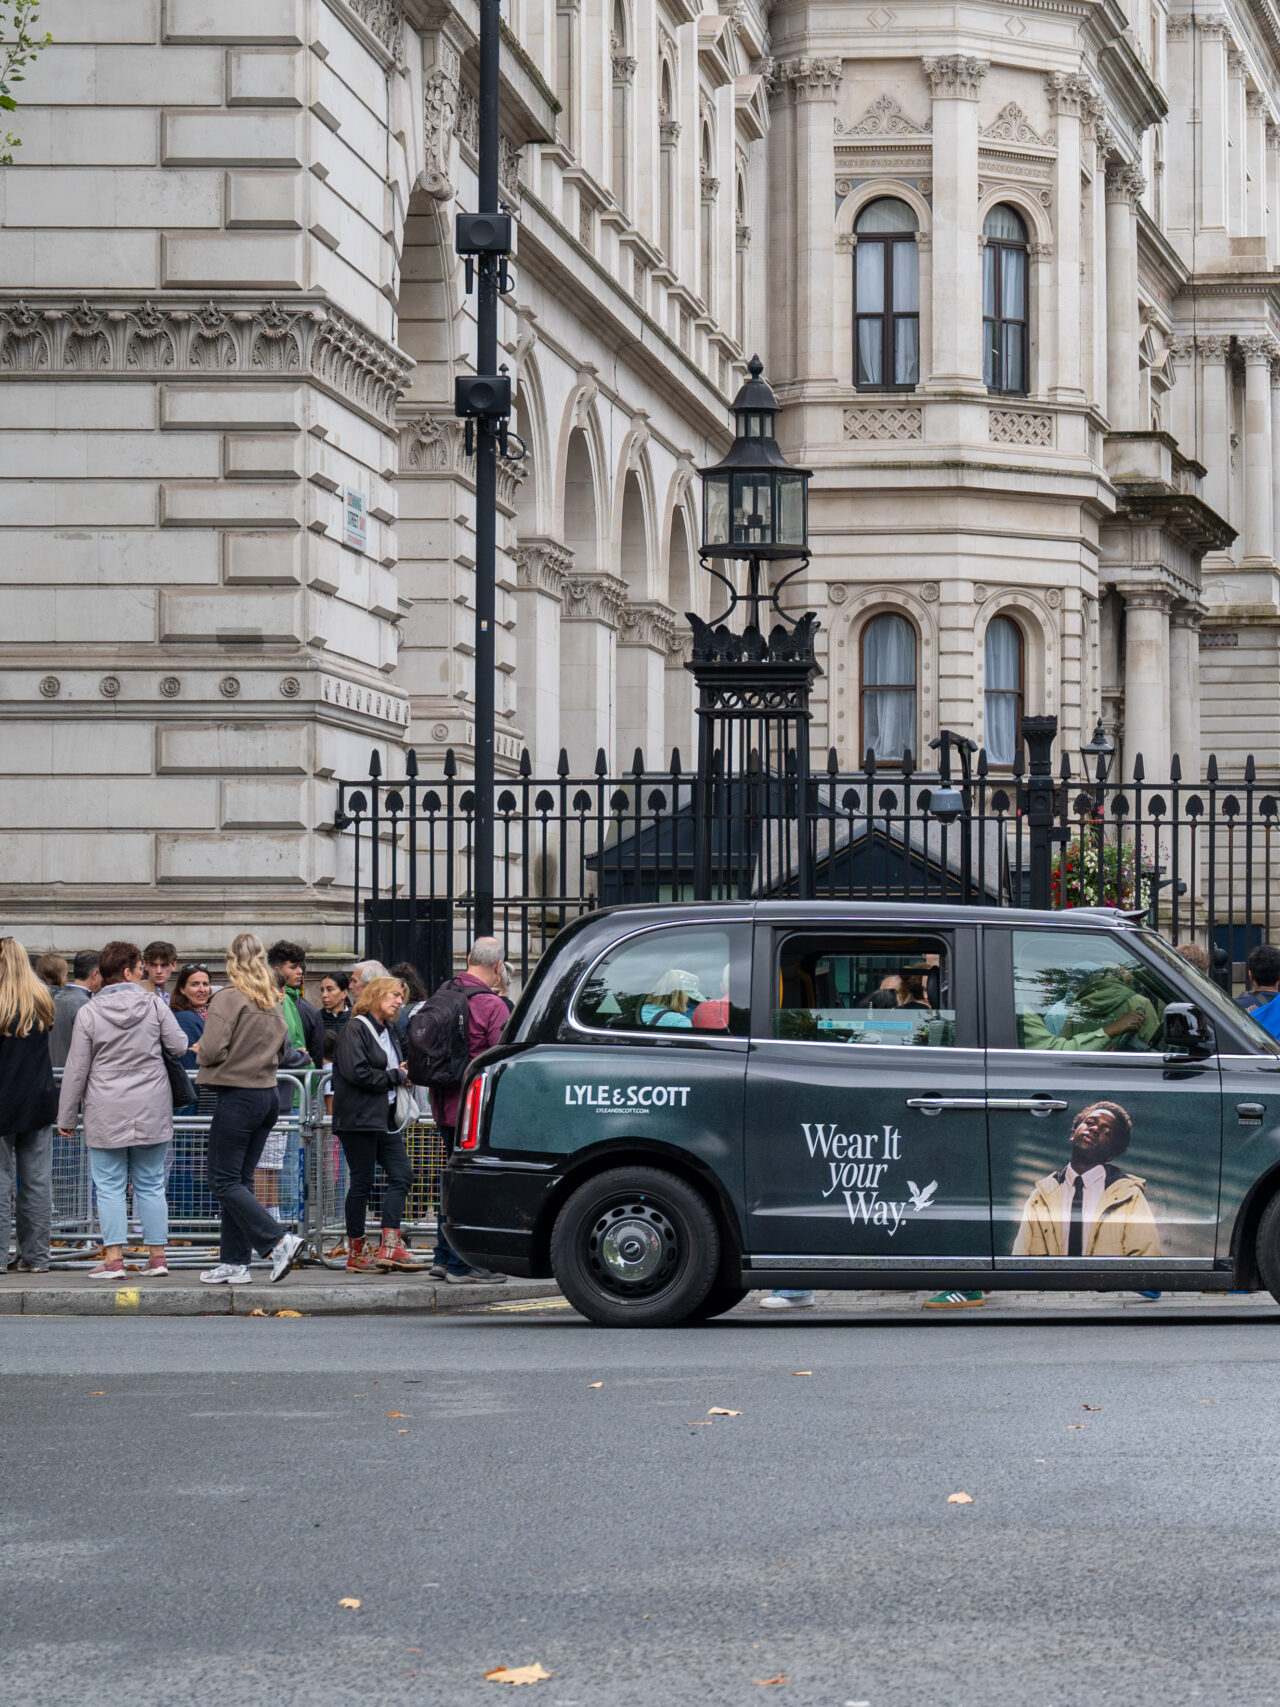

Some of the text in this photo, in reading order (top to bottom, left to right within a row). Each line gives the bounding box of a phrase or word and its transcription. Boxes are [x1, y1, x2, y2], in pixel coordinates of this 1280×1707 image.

[565, 1085, 611, 1106] LYLE
[626, 1085, 691, 1107] SCOTT
[801, 1123, 902, 1160] Wear It
[822, 1162, 888, 1198] your
[842, 1191, 907, 1237] Way.
